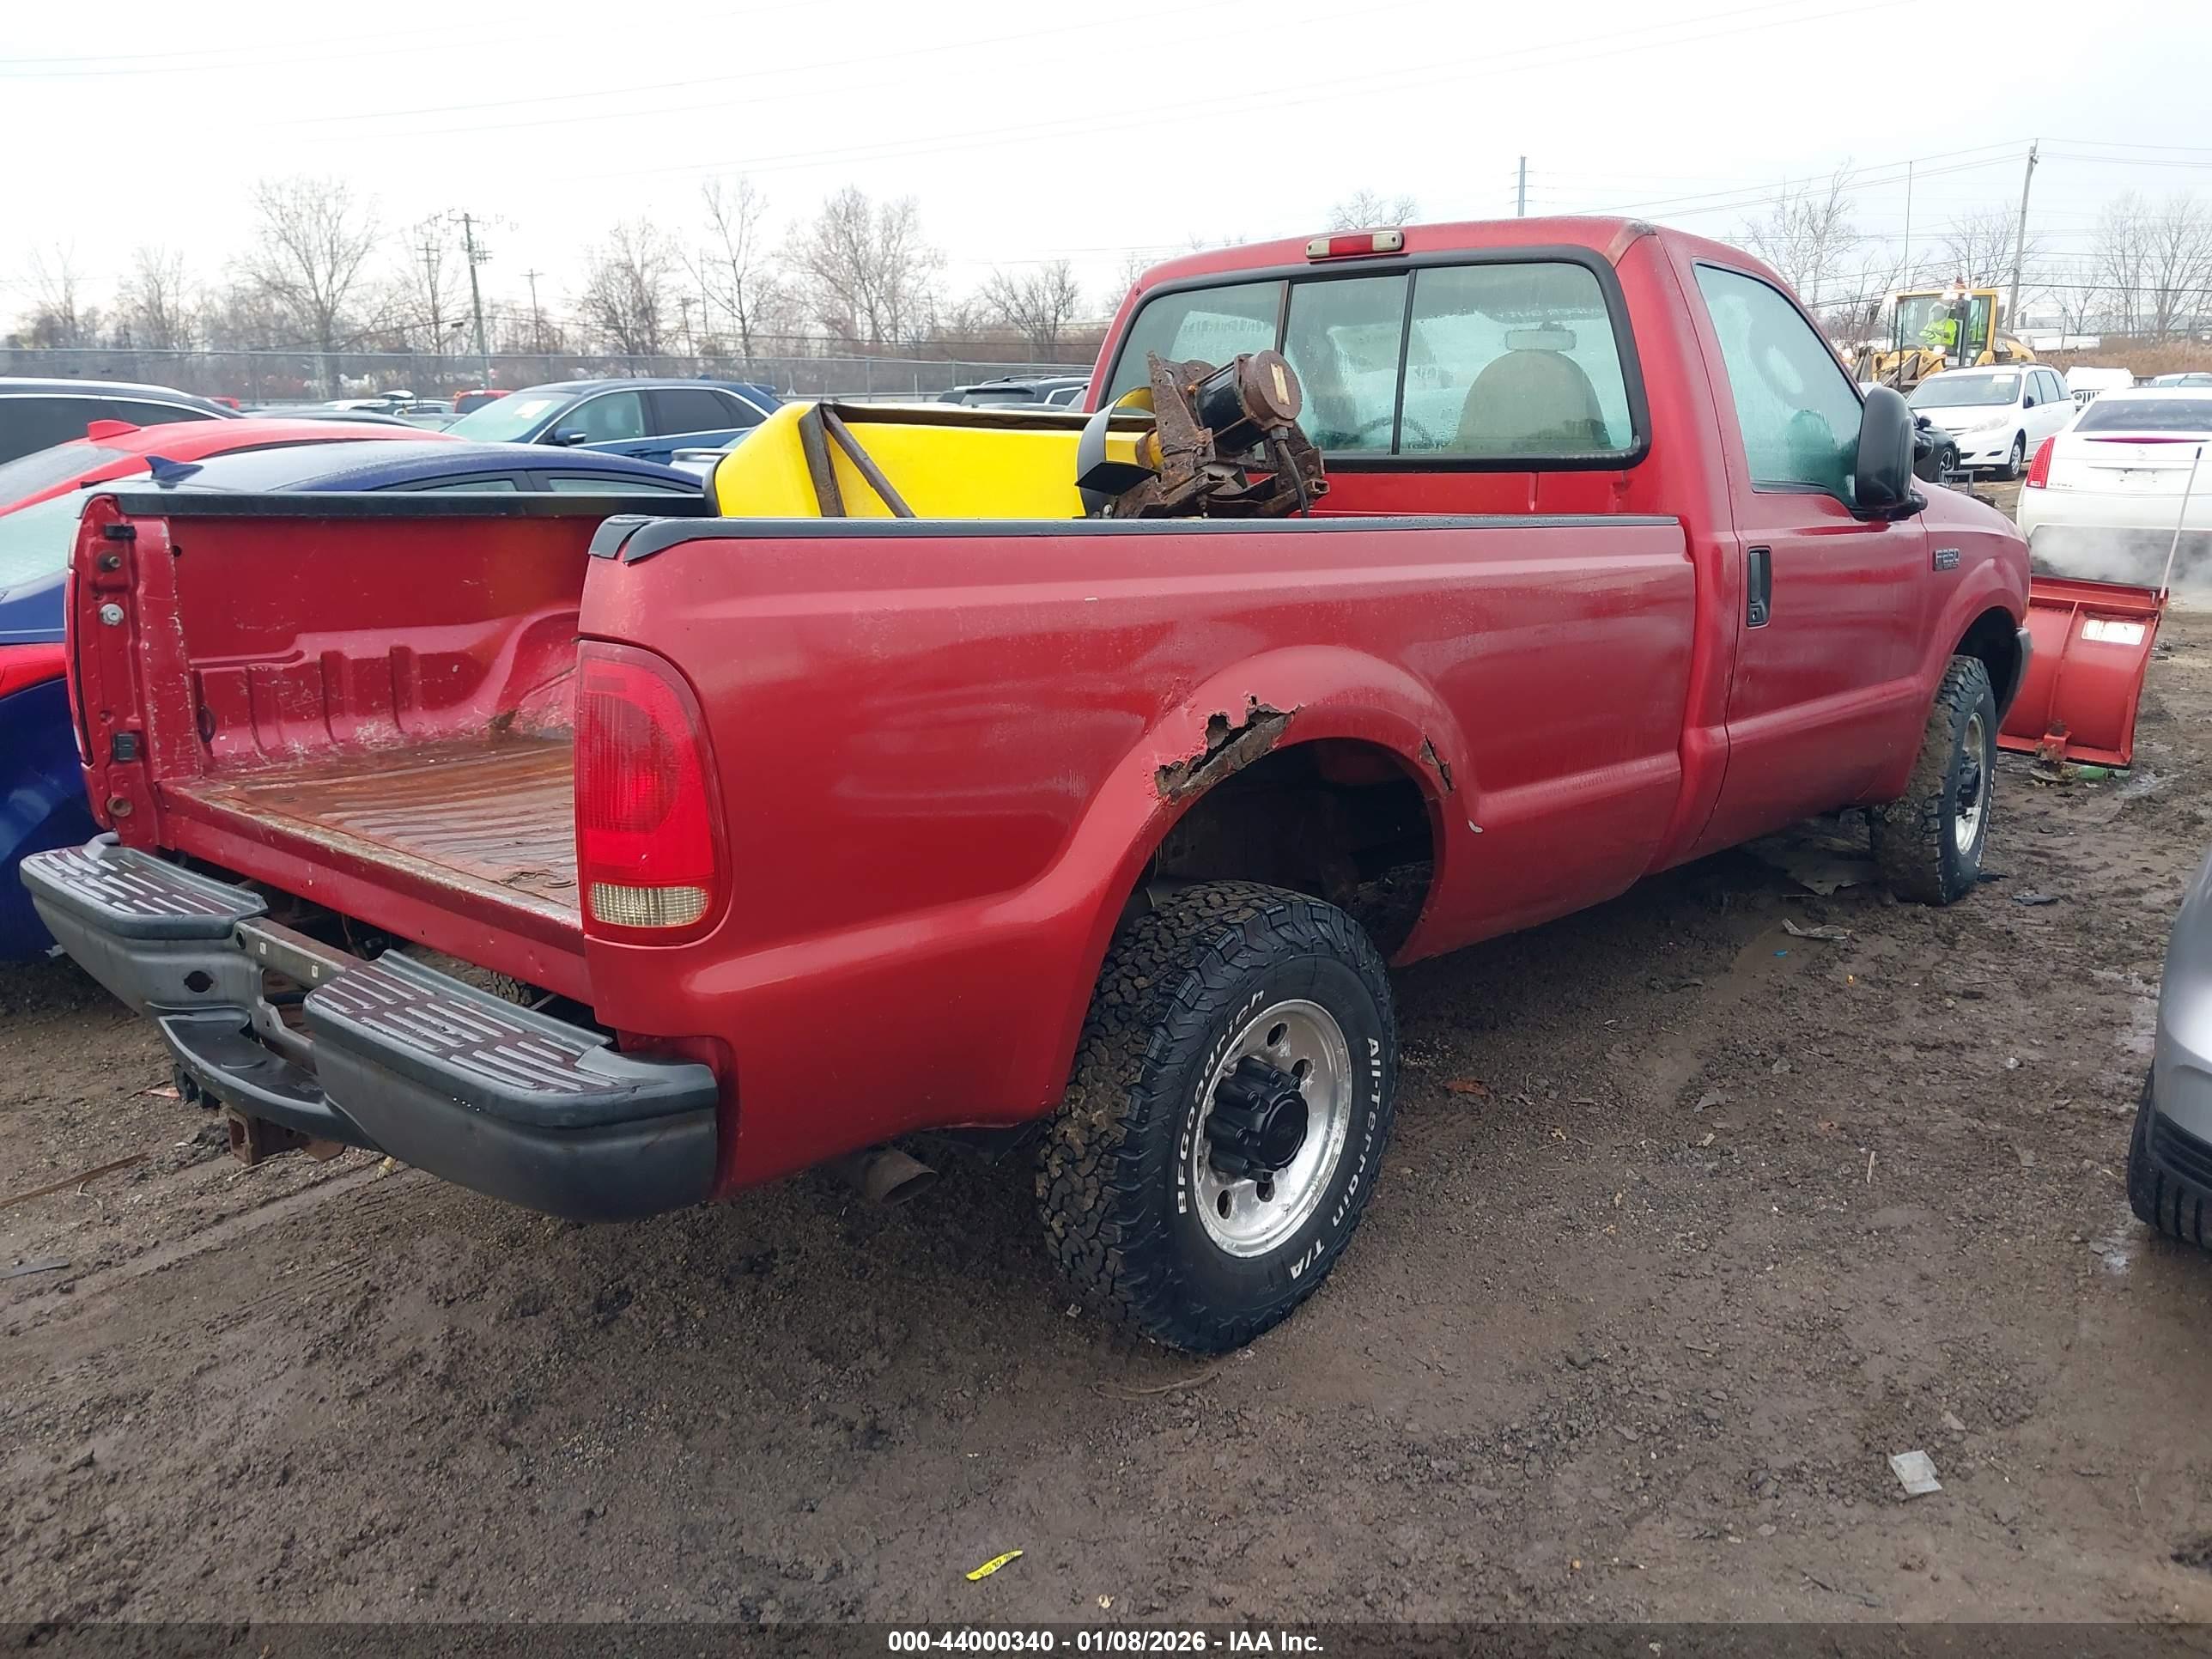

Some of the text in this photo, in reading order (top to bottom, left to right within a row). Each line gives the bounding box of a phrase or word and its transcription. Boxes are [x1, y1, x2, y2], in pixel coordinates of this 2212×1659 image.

[1176, 989, 1265, 1214] BFGoodrich
[1333, 1037, 1382, 1227] All-Terrain
[1290, 1237, 1326, 1279] T/A
